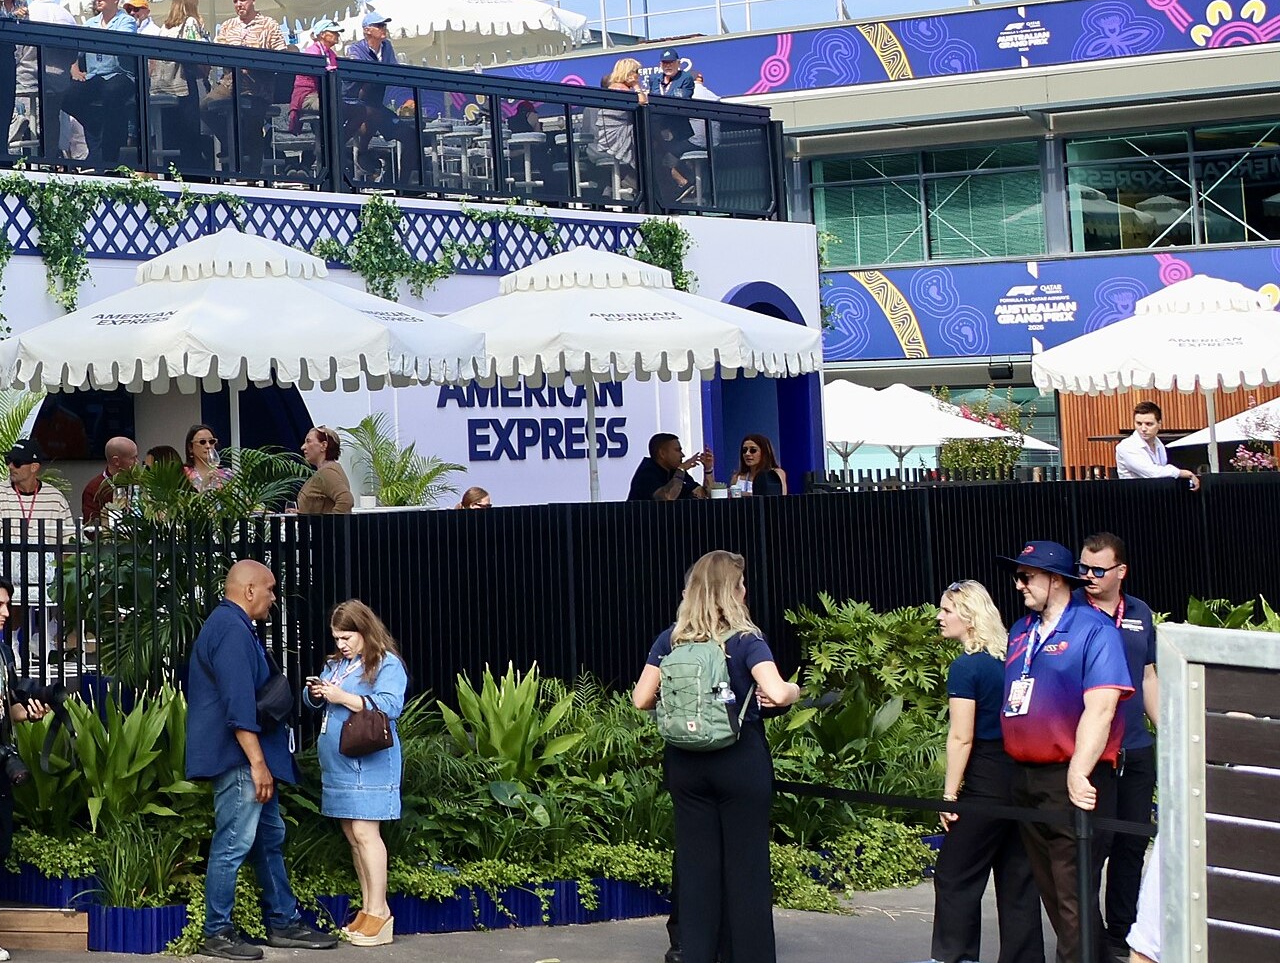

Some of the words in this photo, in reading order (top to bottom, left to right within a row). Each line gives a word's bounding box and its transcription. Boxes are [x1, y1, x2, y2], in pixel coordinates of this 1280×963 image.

[1039, 284, 1062, 292] QATAR
[994, 301, 1077, 315] AUSTRALIAN
[91, 310, 178, 319] AMERICAN
[997, 313, 1043, 324] GRAND
[1043, 311, 1075, 323] PRIX
[96, 317, 170, 326] EXPRESS
[467, 417, 629, 462] EXPRESS
